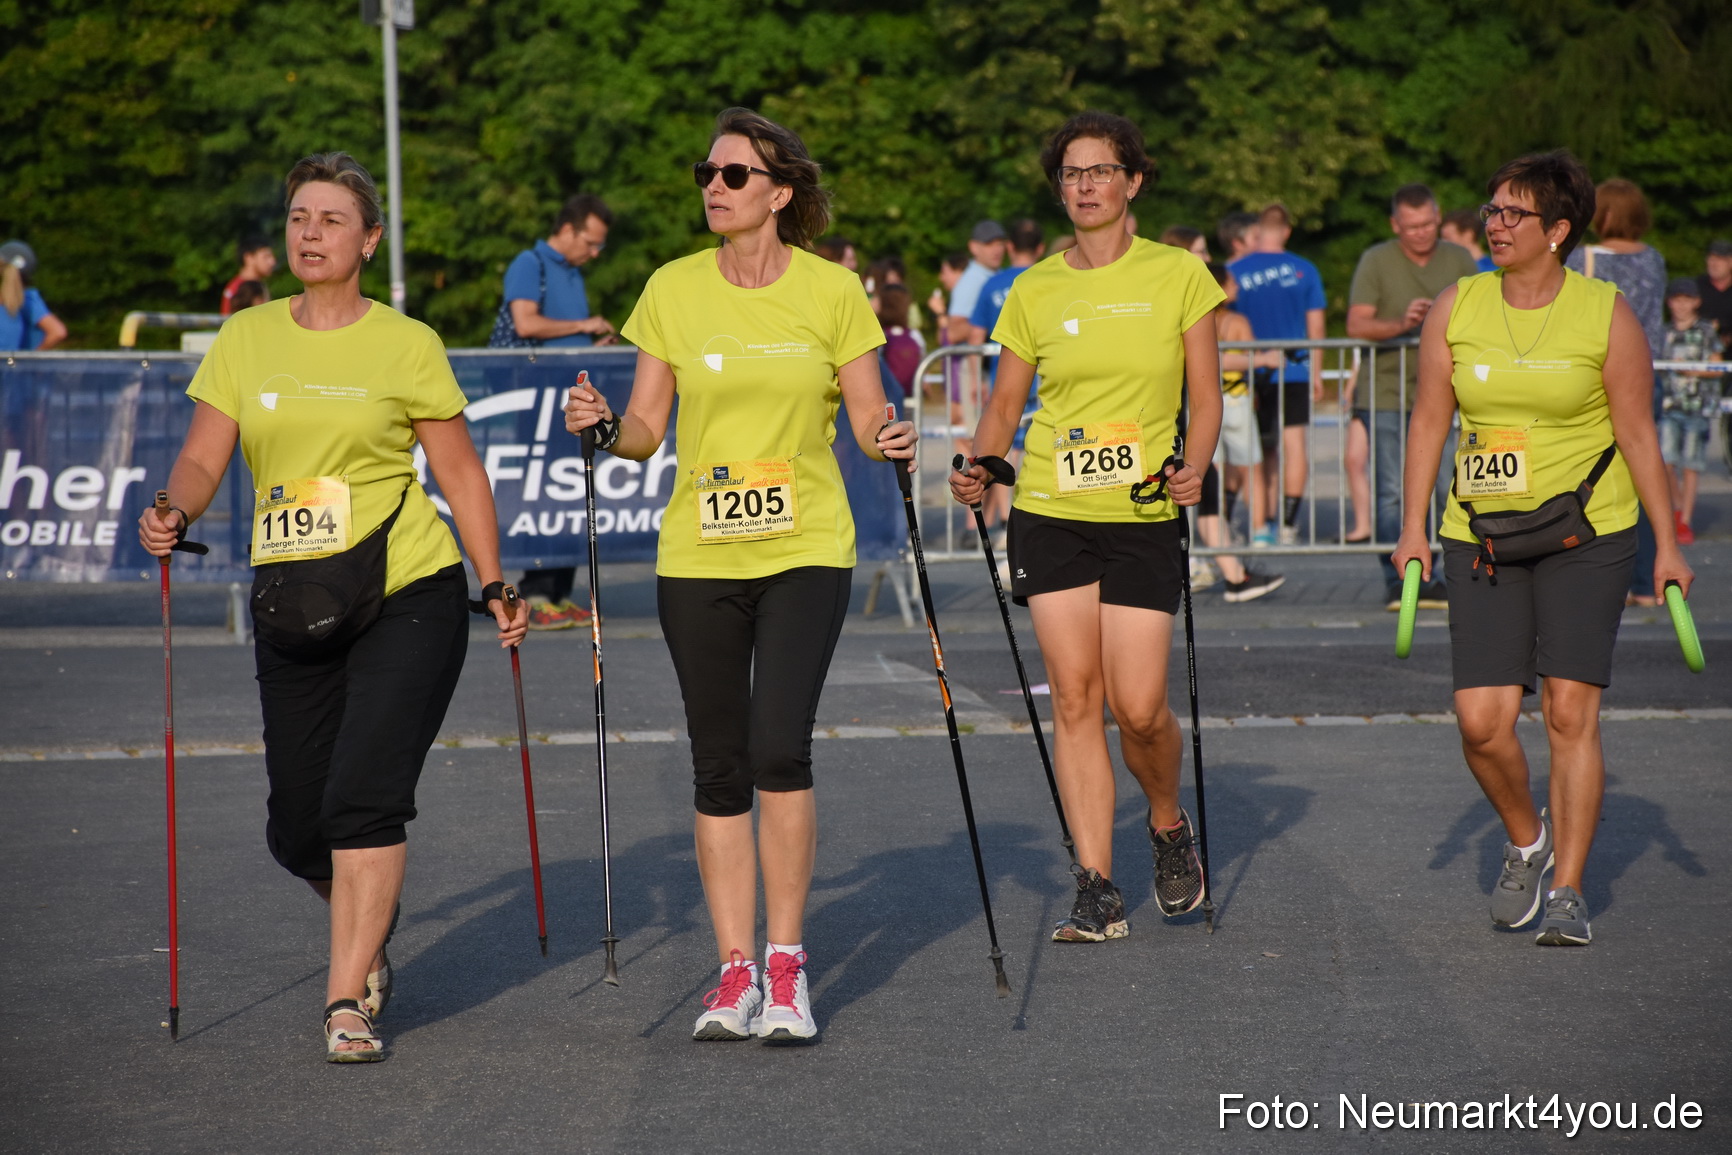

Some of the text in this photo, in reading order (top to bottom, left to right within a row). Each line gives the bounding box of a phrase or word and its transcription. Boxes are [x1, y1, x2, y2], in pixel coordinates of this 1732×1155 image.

[602, 429, 618, 449] EKI
[1063, 445, 1134, 476] 1268
[1464, 453, 1518, 480] 1240
[707, 476, 745, 487] firmenlauf
[770, 477, 789, 486] 2019
[1082, 473, 1117, 483] Ott Sigrid
[706, 486, 784, 521] 1205
[262, 506, 337, 541] 1194
[765, 515, 793, 525] Manika
[261, 537, 338, 551] Amberger Rosmarie
